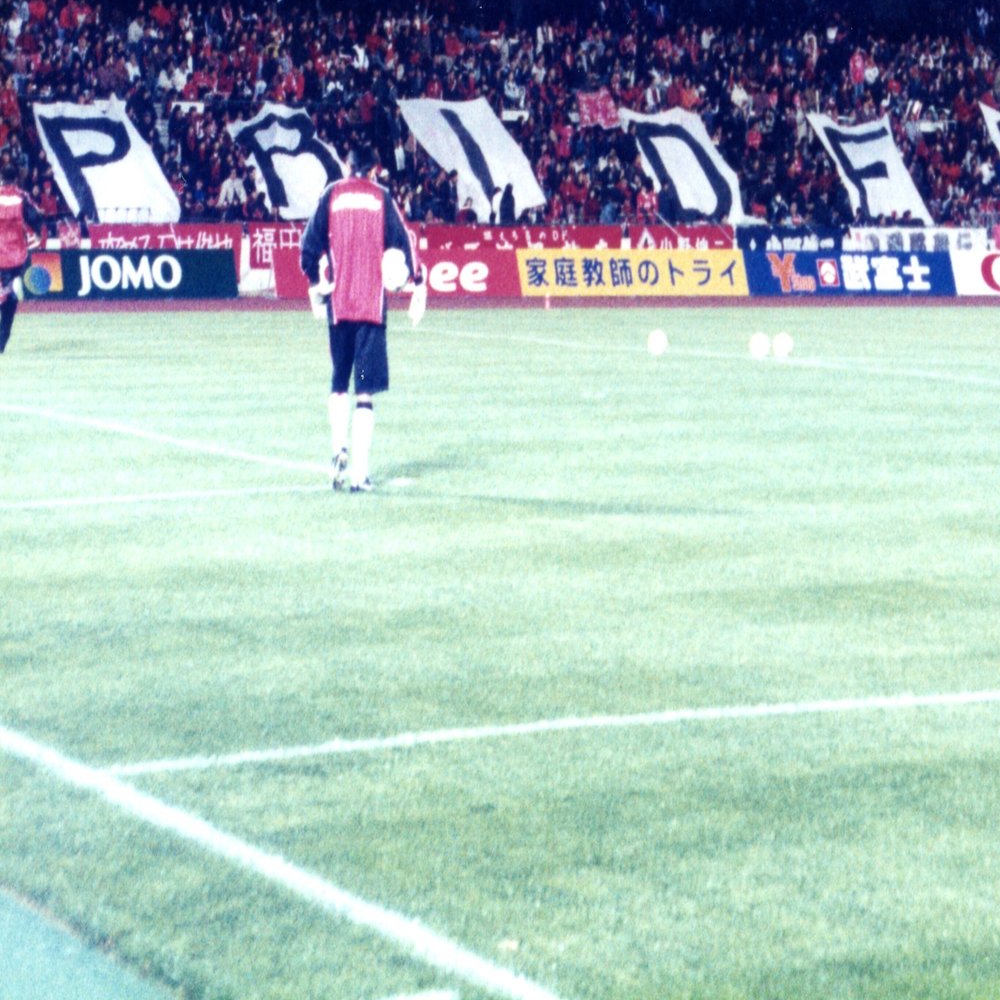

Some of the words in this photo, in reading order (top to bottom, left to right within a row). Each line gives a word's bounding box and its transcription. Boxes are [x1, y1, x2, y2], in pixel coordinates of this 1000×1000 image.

[78, 254, 182, 297] JOMO
[525, 257, 738, 288] 家庭教師のトライ
